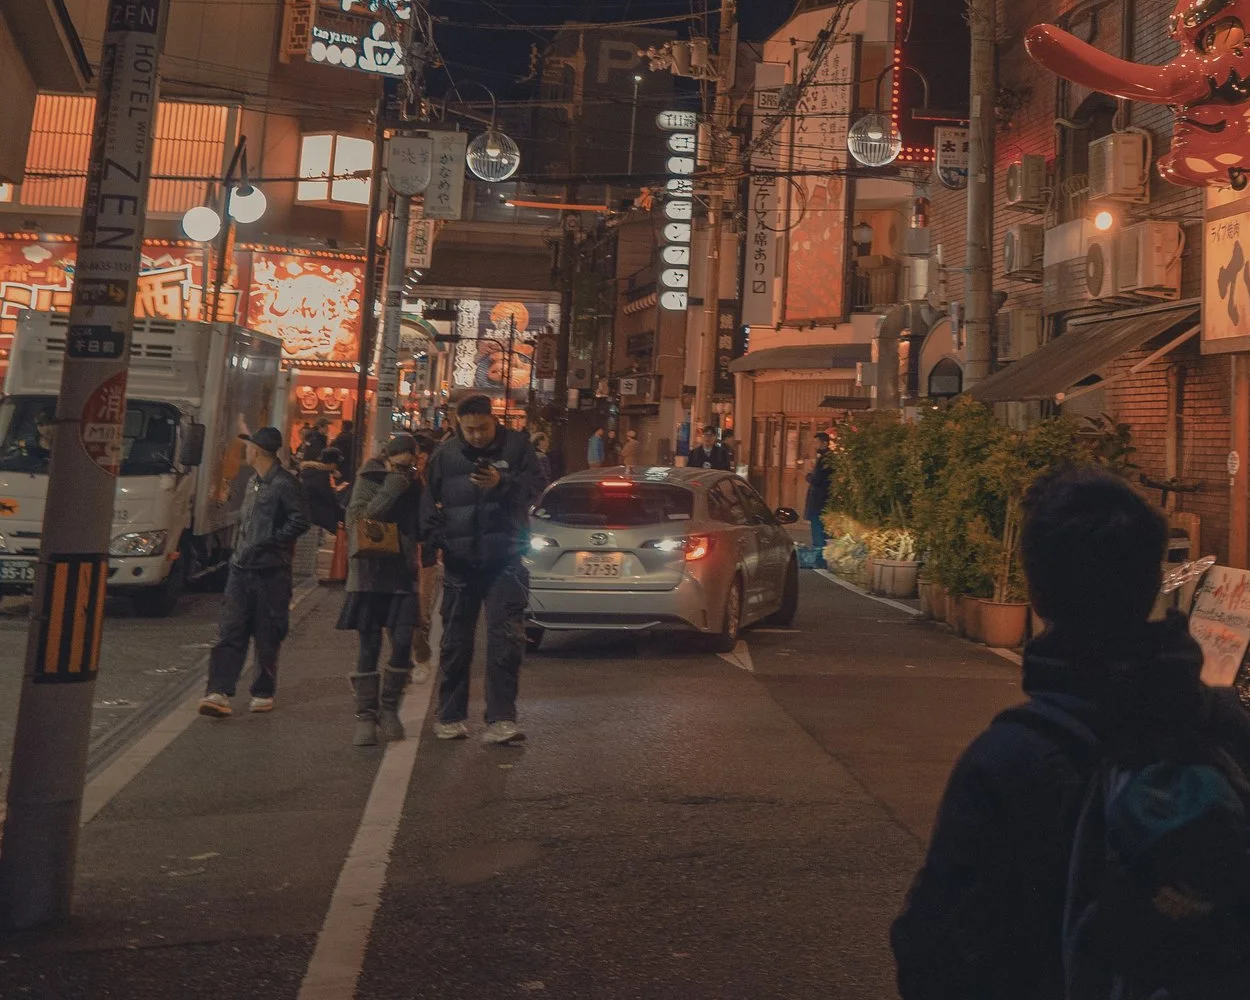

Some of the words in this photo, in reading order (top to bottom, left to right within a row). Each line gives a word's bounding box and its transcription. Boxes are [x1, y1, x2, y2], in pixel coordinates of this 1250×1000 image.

[111, 3, 156, 27] ZEN
[128, 43, 154, 119] HOTEL
[136, 120, 148, 155] WITH
[95, 156, 142, 251] ZEN
[584, 563, 619, 576] 27-95
